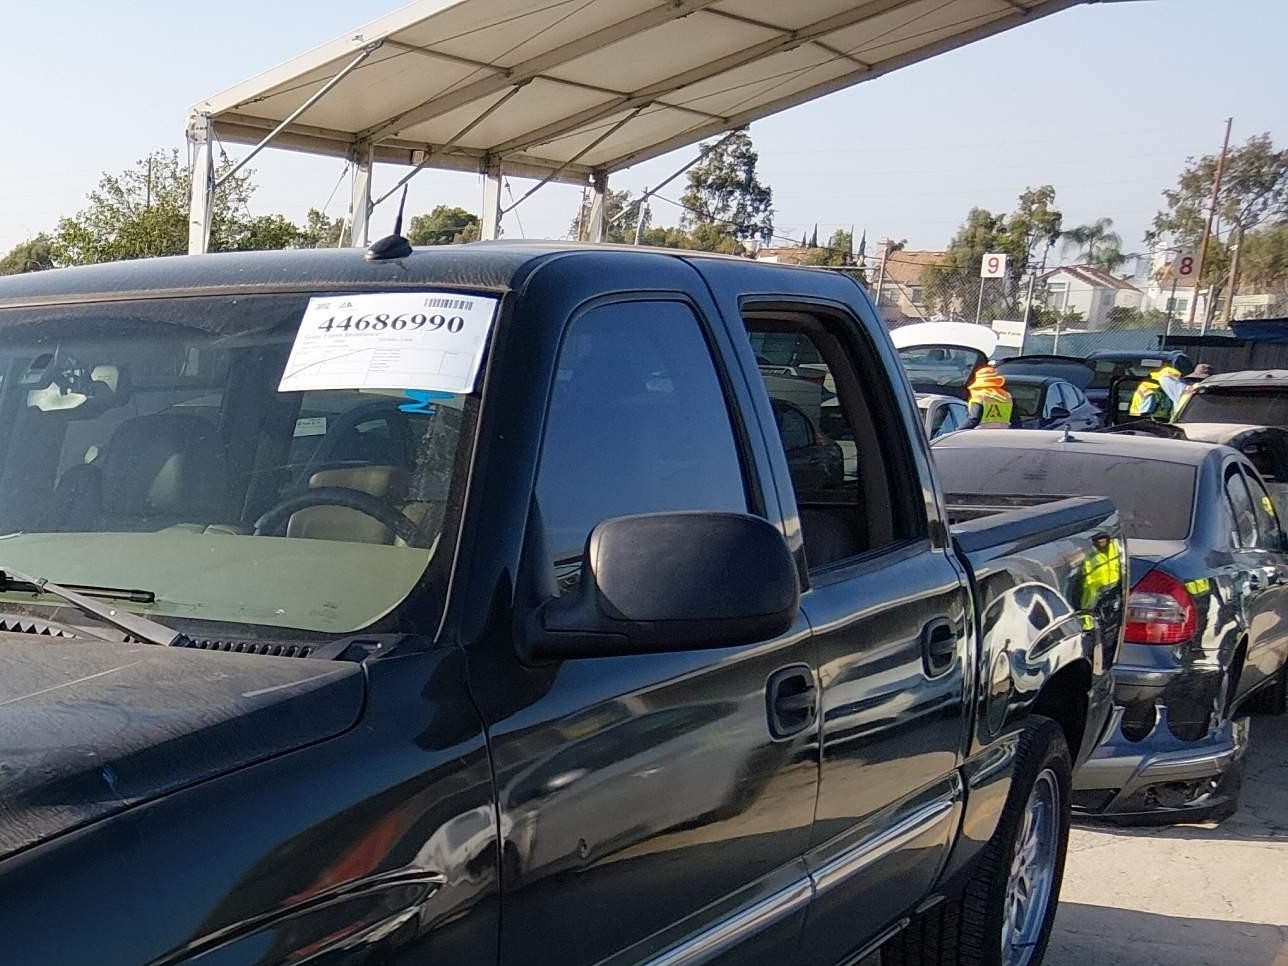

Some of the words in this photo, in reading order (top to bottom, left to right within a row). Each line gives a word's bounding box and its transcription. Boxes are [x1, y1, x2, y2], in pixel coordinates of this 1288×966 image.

[987, 257, 999, 274] 9
[1180, 256, 1192, 275] 8
[318, 314, 465, 333] 44686990
